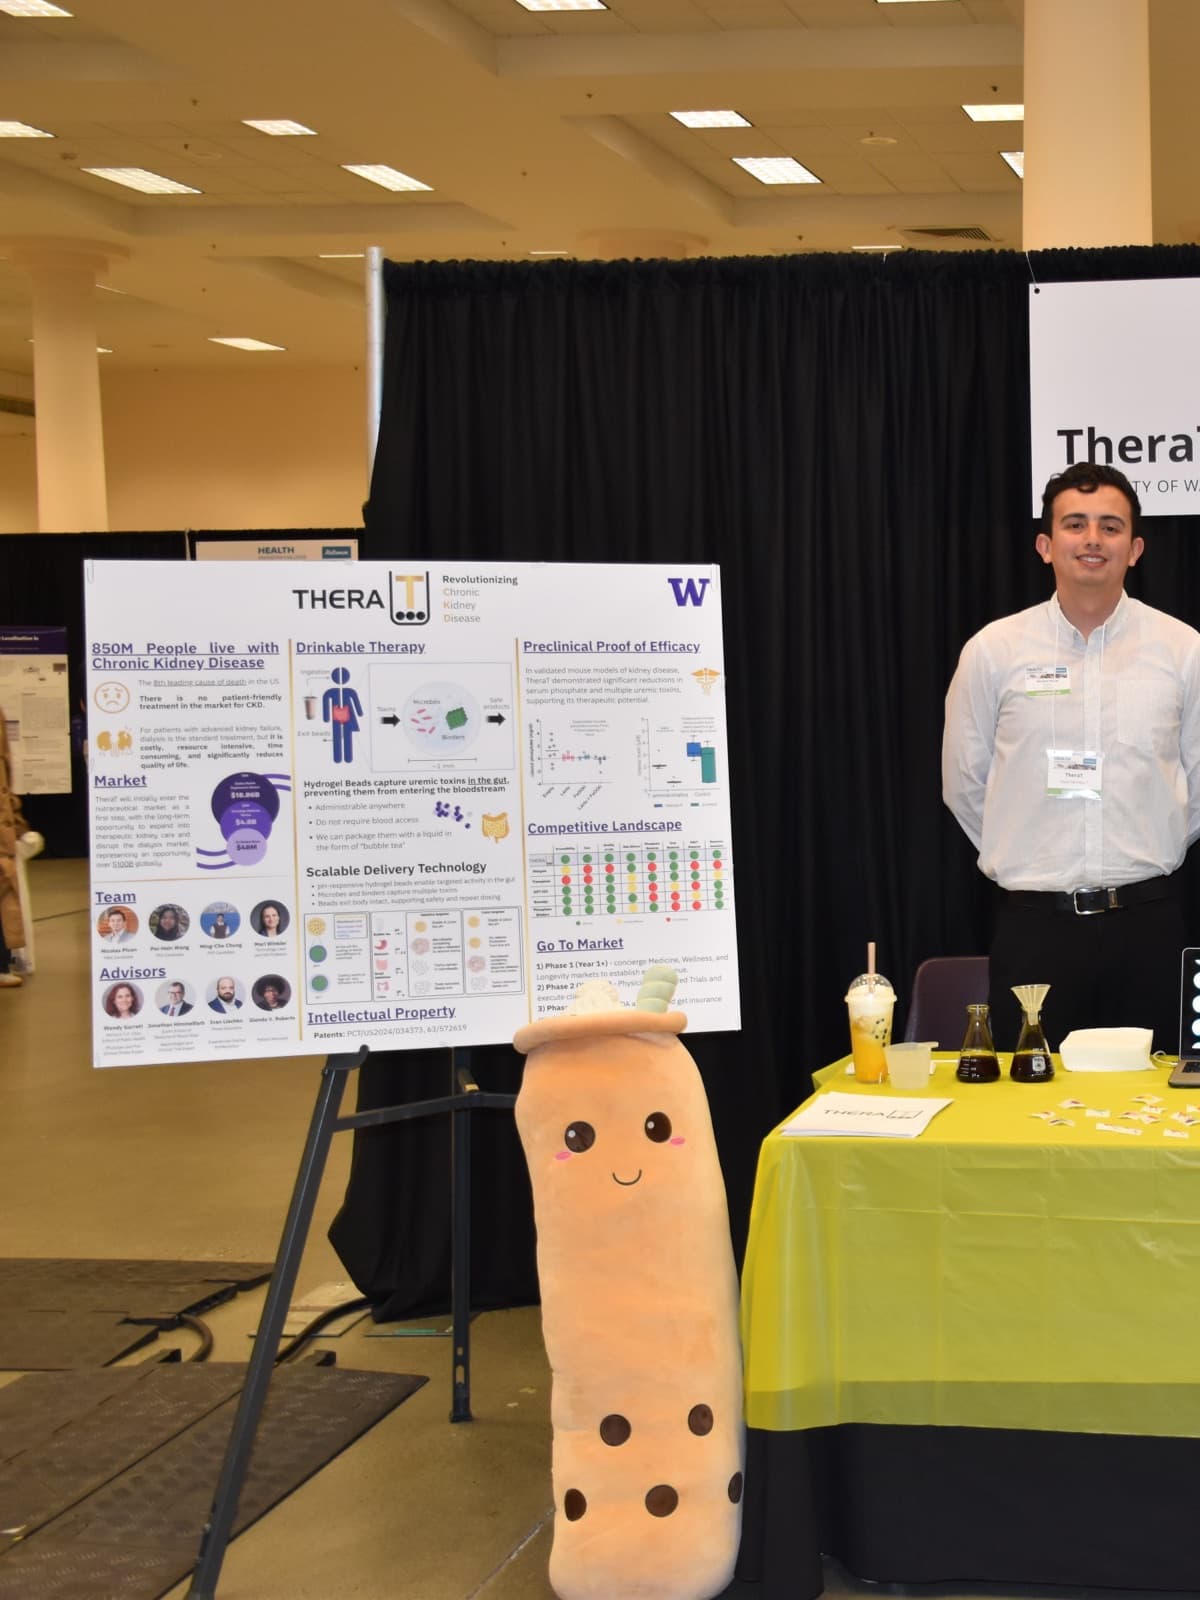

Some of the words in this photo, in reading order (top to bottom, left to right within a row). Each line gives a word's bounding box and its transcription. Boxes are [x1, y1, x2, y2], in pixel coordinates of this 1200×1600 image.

[1157, 479, 1179, 493] OF
[258, 547, 295, 555] HEALTH
[442, 575, 519, 586] Revolutionizing
[443, 587, 480, 597] Chronic
[668, 578, 710, 607] W
[293, 589, 385, 609] THERA
[443, 600, 476, 611] Kidney
[443, 613, 481, 624] Disease
[92, 643, 133, 654] 850M
[146, 643, 197, 656] People
[209, 643, 235, 653] live
[247, 643, 279, 653] with
[296, 642, 364, 653] Drinkable
[368, 642, 426, 655] Therapy
[524, 641, 592, 652] Preclinical
[596, 641, 630, 652] Proof
[633, 641, 646, 652] of
[649, 641, 700, 654] Efficacy
[92, 658, 149, 669] Chronic
[153, 657, 204, 671] Kidney
[208, 657, 264, 668] Disease
[628, 667, 651, 675] kidney
[602, 677, 637, 685] significant
[550, 687, 588, 695] phosphate
[604, 687, 632, 695] multiple
[221, 694, 282, 703] patient-friendly
[526, 697, 565, 706] supporting
[576, 697, 614, 705] therapeutic
[94, 775, 147, 786] Market
[304, 780, 342, 789] Hydrogel
[344, 779, 371, 787] Beads
[373, 779, 406, 788] capture
[408, 778, 438, 786] uremic
[439, 778, 466, 786] toxins
[476, 777, 492, 785] the
[493, 777, 510, 786] gut,
[304, 788, 351, 798] preventing
[352, 788, 375, 796] them
[377, 787, 397, 795] from
[399, 787, 435, 796] entering
[436, 786, 450, 794] the
[452, 785, 506, 793] bloodstream
[315, 803, 367, 811] Administrable
[368, 802, 406, 811] anywhere
[342, 818, 370, 826] require
[528, 821, 609, 837] Competitive
[612, 820, 682, 835] Landscape
[315, 833, 328, 841] We
[344, 832, 376, 842] package
[377, 831, 397, 839] them
[398, 831, 414, 839] with
[422, 830, 443, 840] liquid
[316, 843, 329, 851] the
[306, 866, 360, 878] Scalable
[363, 864, 414, 879] Delivery
[417, 862, 486, 877] Technology
[95, 891, 136, 903] Team
[537, 940, 555, 950] Go
[558, 939, 573, 950] To
[577, 938, 624, 950] Market
[536, 963, 543, 971] 1)
[574, 961, 593, 969] (Year
[614, 959, 647, 968] concierge
[648, 957, 680, 965] Medicine,
[100, 966, 166, 979] Advisors
[536, 972, 569, 982] Longevity
[570, 971, 599, 979] markets
[609, 969, 640, 977] establish
[537, 984, 544, 992] 2)
[308, 1009, 391, 1023] Intellectual
[395, 1007, 456, 1022] Property
[314, 1031, 345, 1039] Patents:
